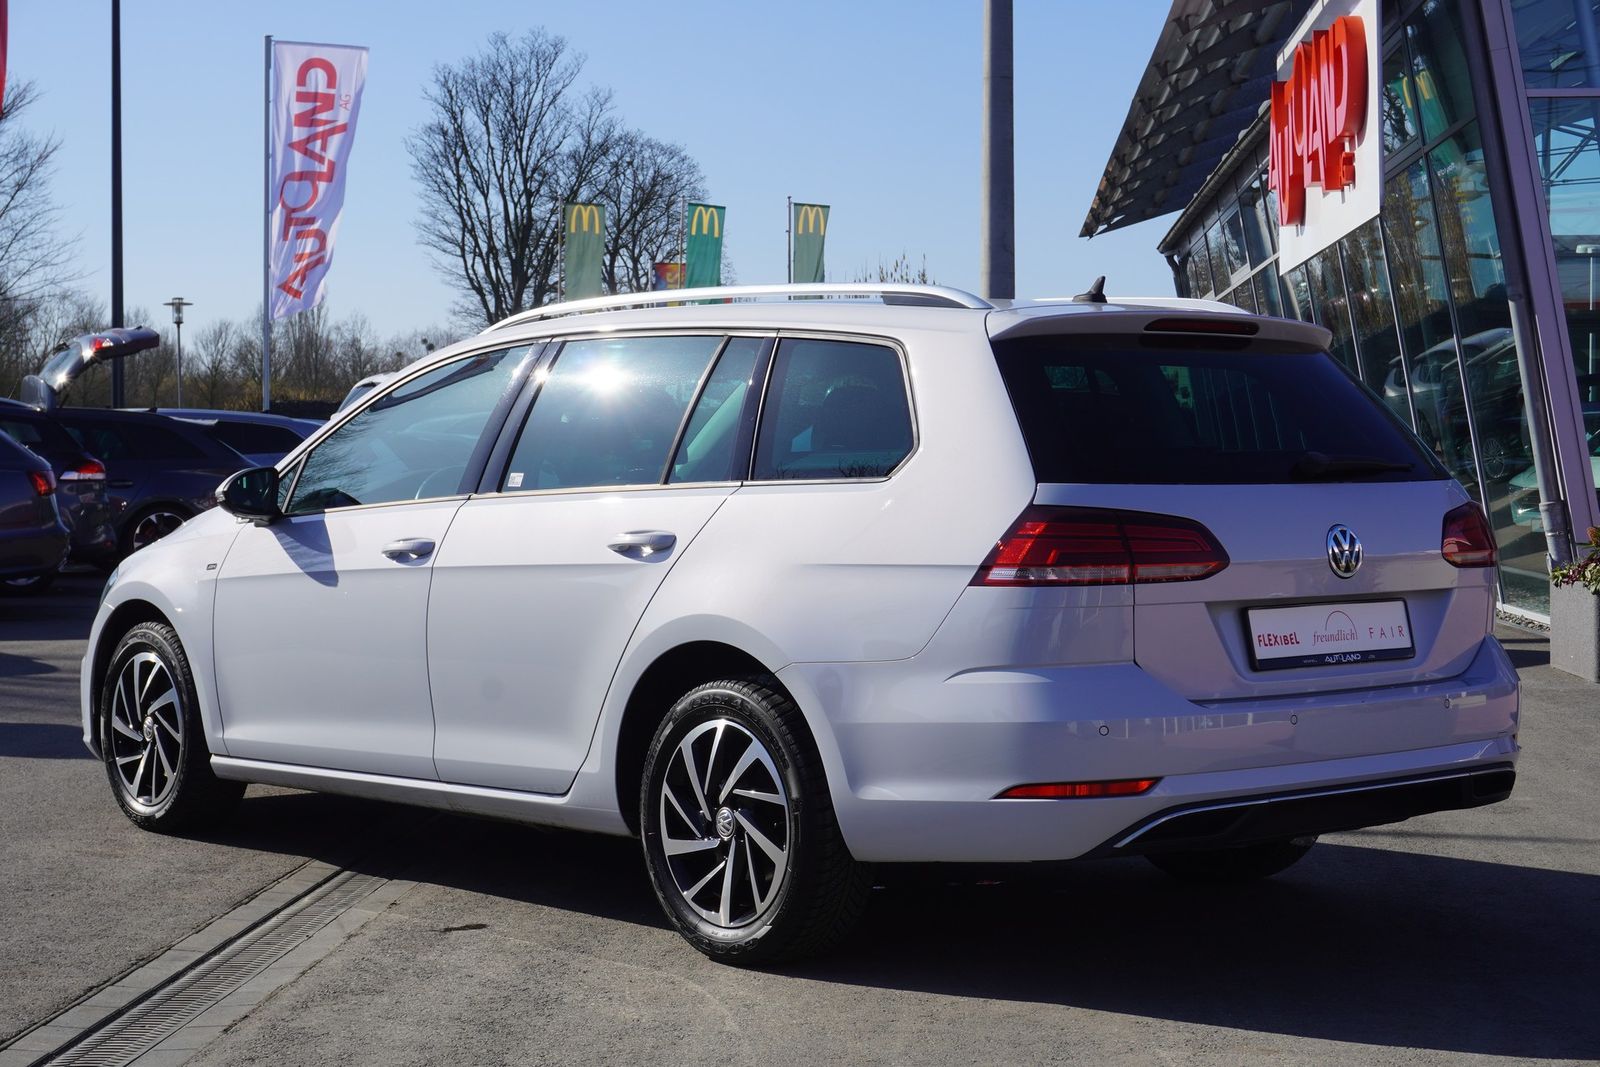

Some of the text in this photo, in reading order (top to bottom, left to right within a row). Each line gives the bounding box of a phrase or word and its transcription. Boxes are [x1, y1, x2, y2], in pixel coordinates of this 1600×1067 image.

[339, 94, 352, 111] AG
[277, 57, 348, 299] AUTOLAND
[1257, 632, 1300, 647] FLEXIBEL
